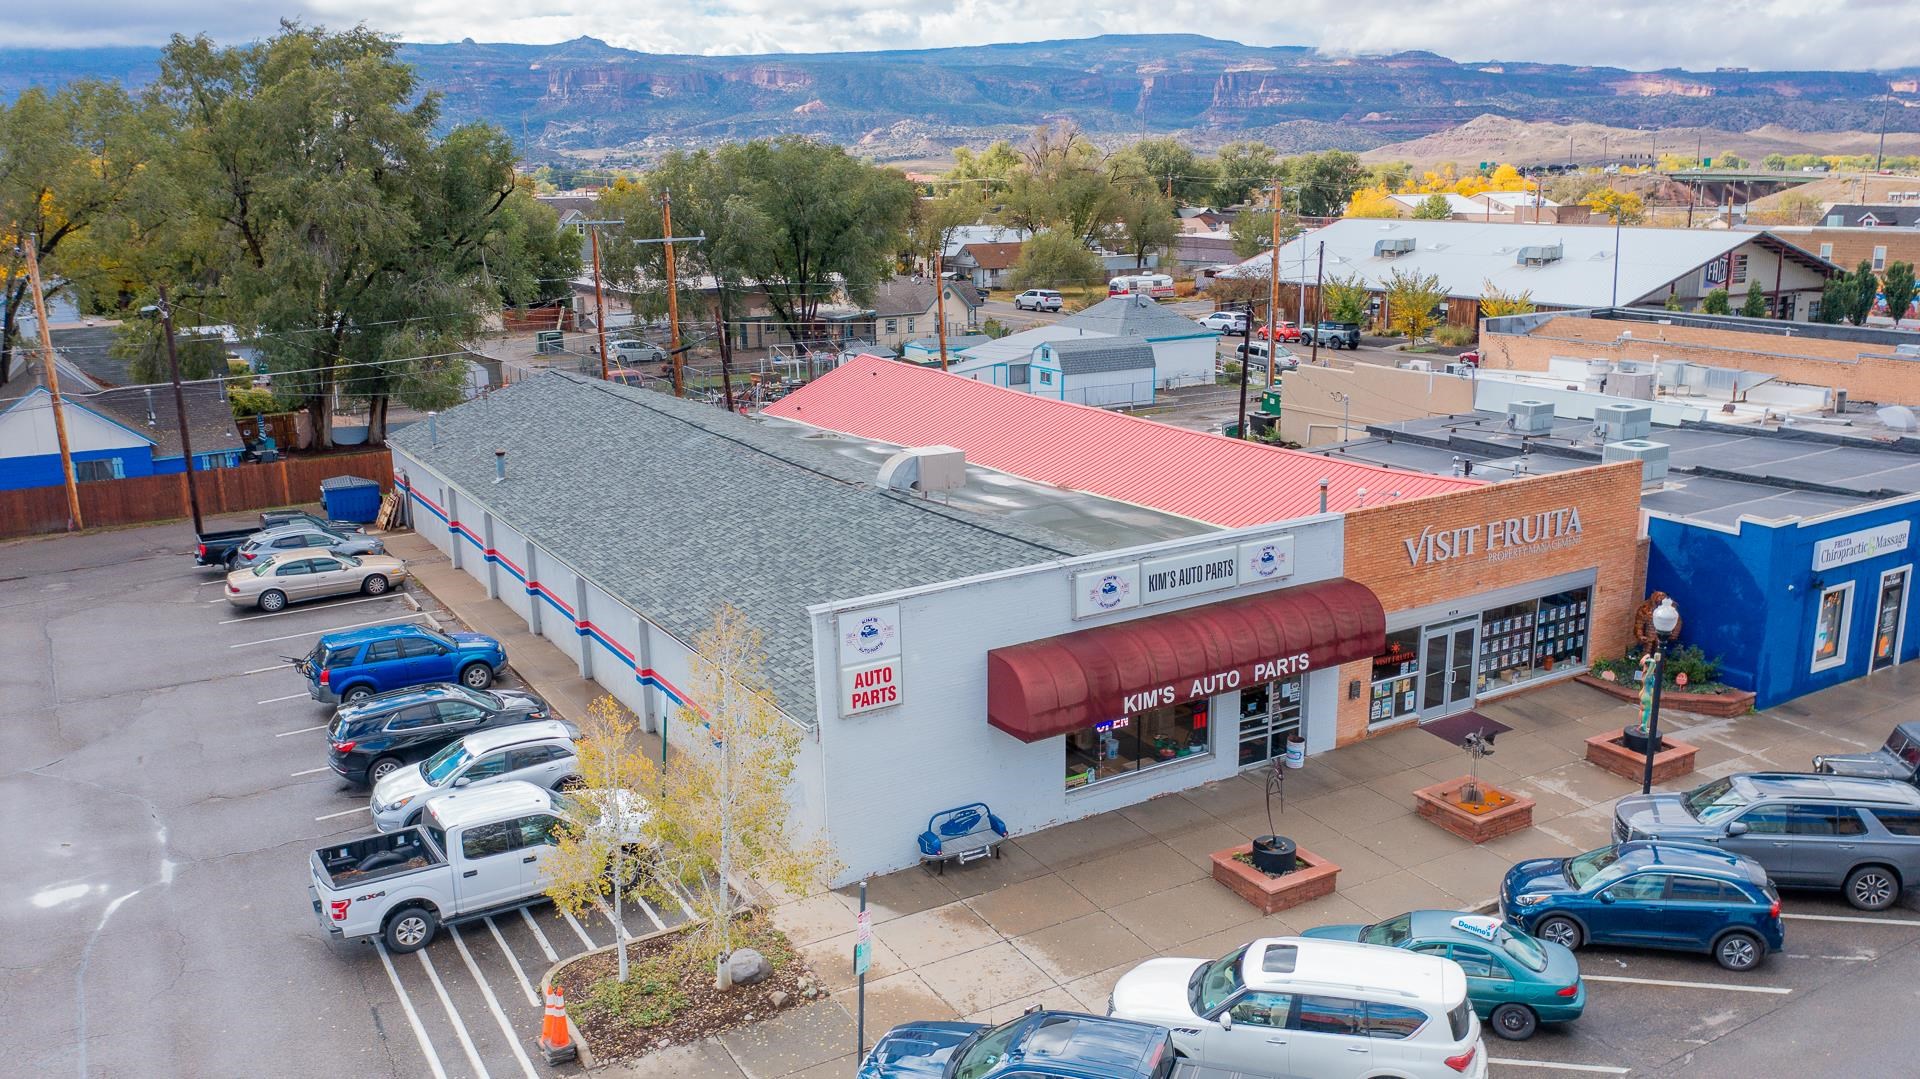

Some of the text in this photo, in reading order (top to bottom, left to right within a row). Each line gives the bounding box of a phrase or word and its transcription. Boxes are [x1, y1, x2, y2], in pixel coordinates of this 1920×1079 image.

[1404, 506, 1583, 567] VISIT FRUITA
[1488, 535, 1582, 564] PROPERTY MANAGEMENT
[1821, 541, 1868, 563] Chiropractic
[1876, 533, 1907, 549] Massage
[1148, 569, 1176, 593] KIM'S
[1178, 565, 1203, 587] AUTO
[1205, 559, 1234, 581] PARTS
[854, 667, 892, 689] AUTO
[1123, 653, 1310, 714] KIM'S AUTO PARTS
[852, 685, 897, 709] PARTS
[1458, 920, 1491, 937] Domino's
